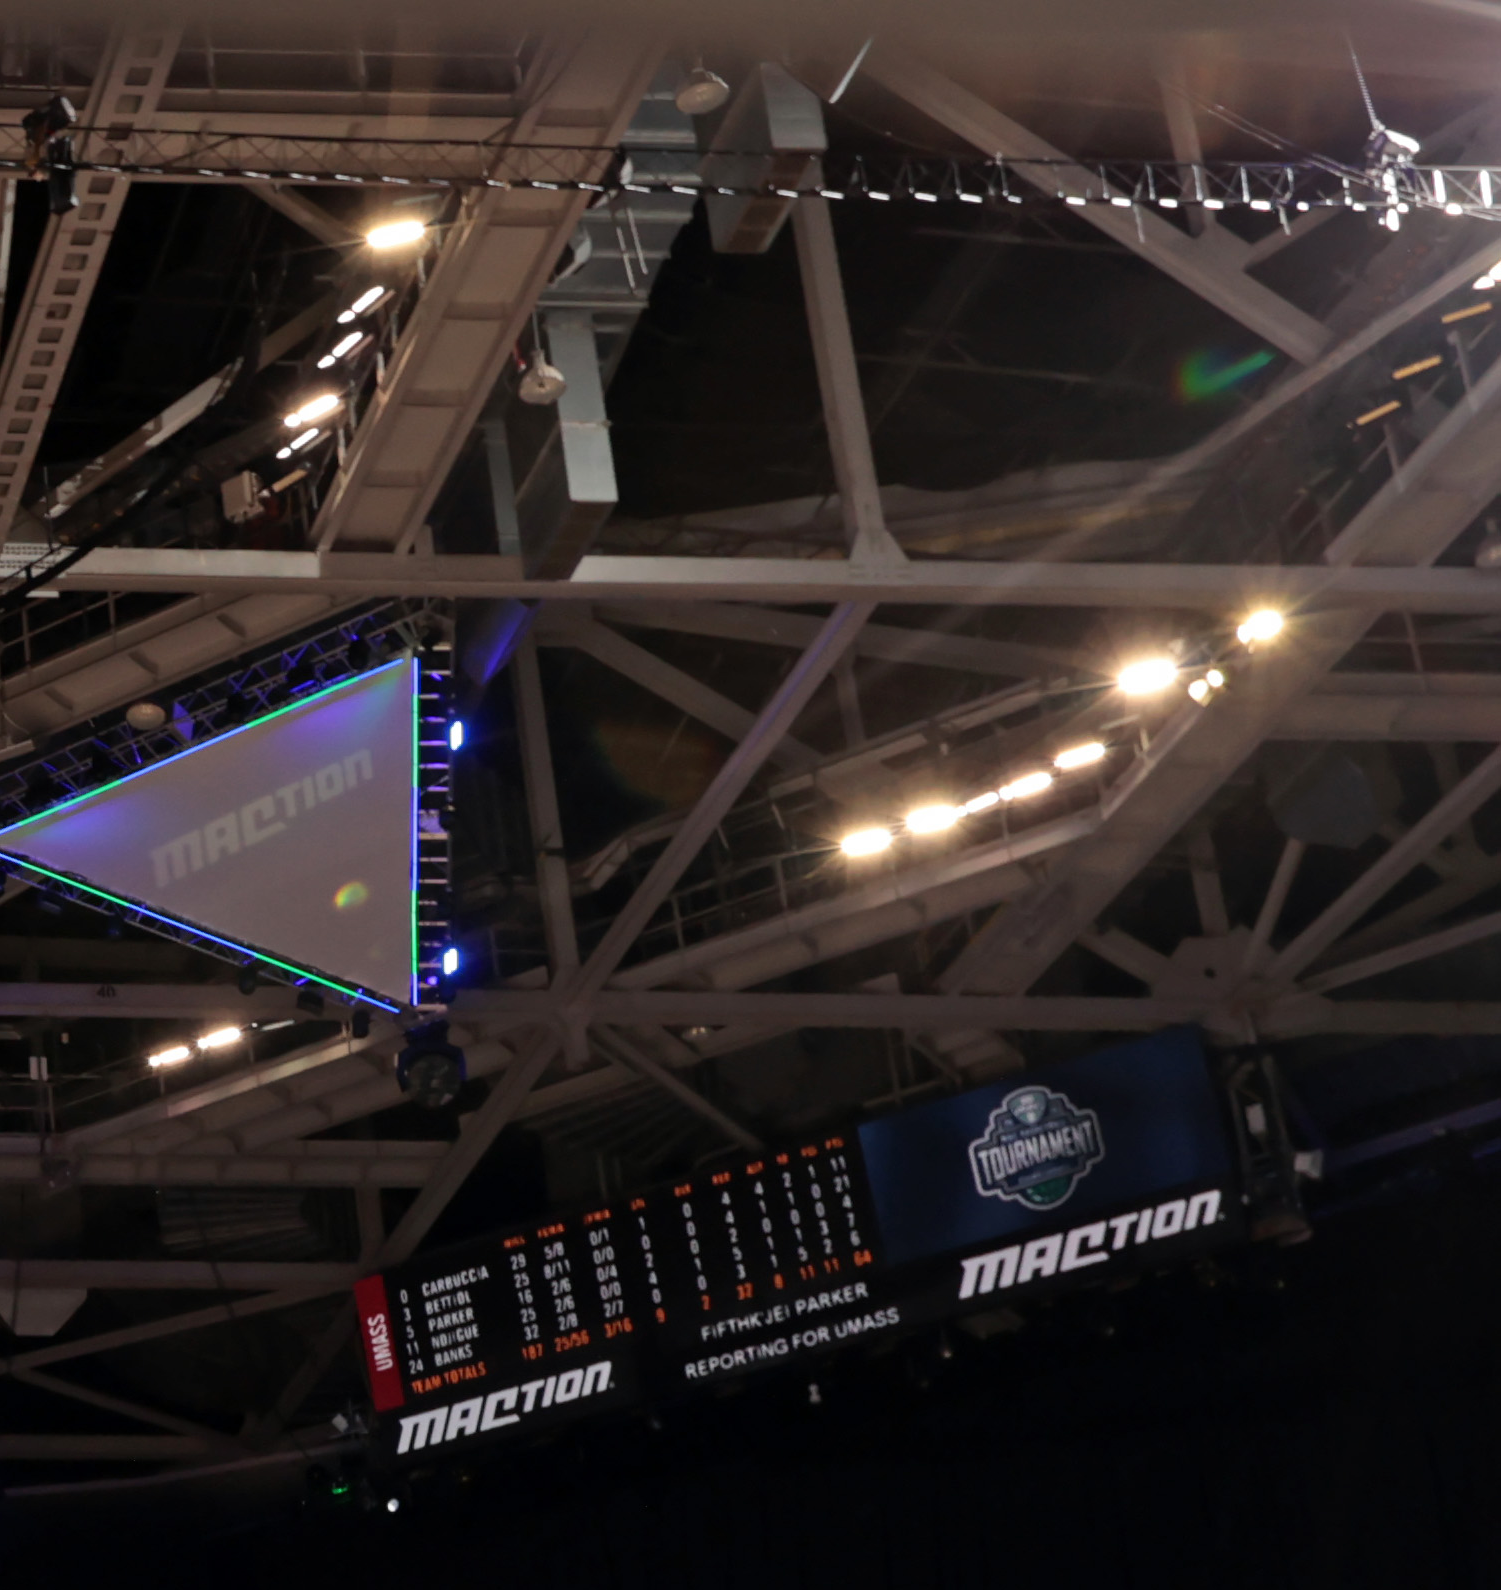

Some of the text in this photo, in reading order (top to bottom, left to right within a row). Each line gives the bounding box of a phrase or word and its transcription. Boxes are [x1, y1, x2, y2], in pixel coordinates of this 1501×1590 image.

[976, 1119, 1096, 1185] TOURNAMENT
[421, 1264, 490, 1298] CARBUCCIA
[794, 1281, 869, 1316] PARKER
[427, 1306, 475, 1332] PARKER
[367, 1313, 393, 1372] UMASS
[434, 1343, 473, 1367] BANKS
[684, 1306, 900, 1379] REPORTING FOR UMASS
[411, 1373, 442, 1395] TEAM
[443, 1360, 487, 1386] TOTALS
